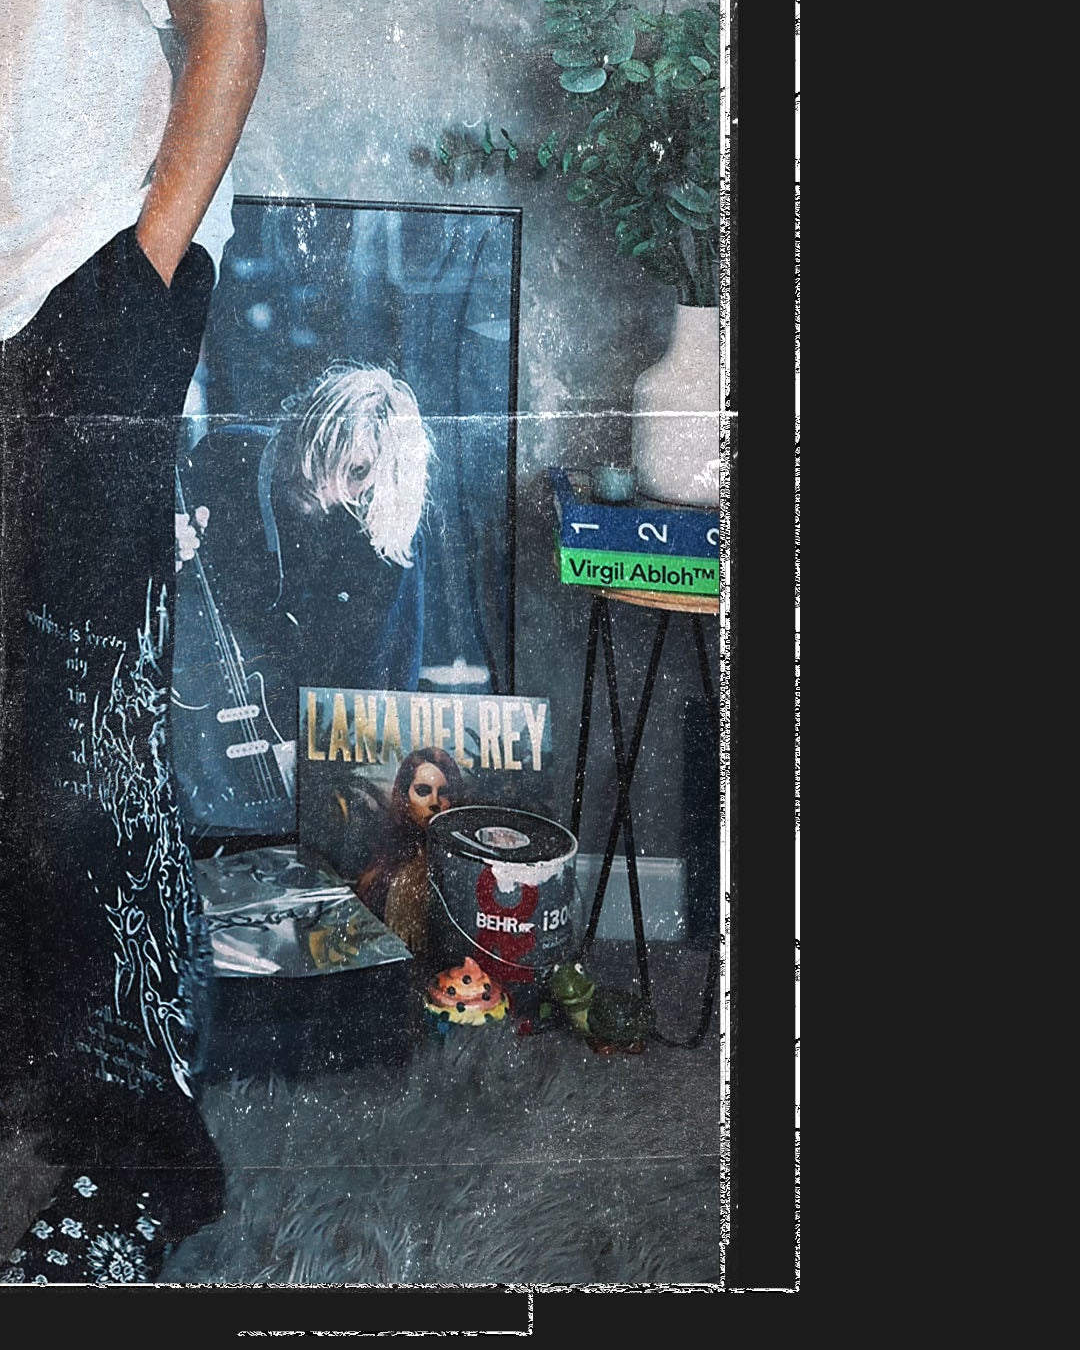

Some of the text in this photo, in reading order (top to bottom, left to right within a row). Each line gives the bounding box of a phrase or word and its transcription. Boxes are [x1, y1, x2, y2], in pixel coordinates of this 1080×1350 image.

[570, 522, 600, 534] 1
[637, 522, 668, 543] 2
[570, 558, 624, 585] Virgil
[306, 691, 548, 772] LANA DEL REY
[476, 911, 518, 933] BEHR
